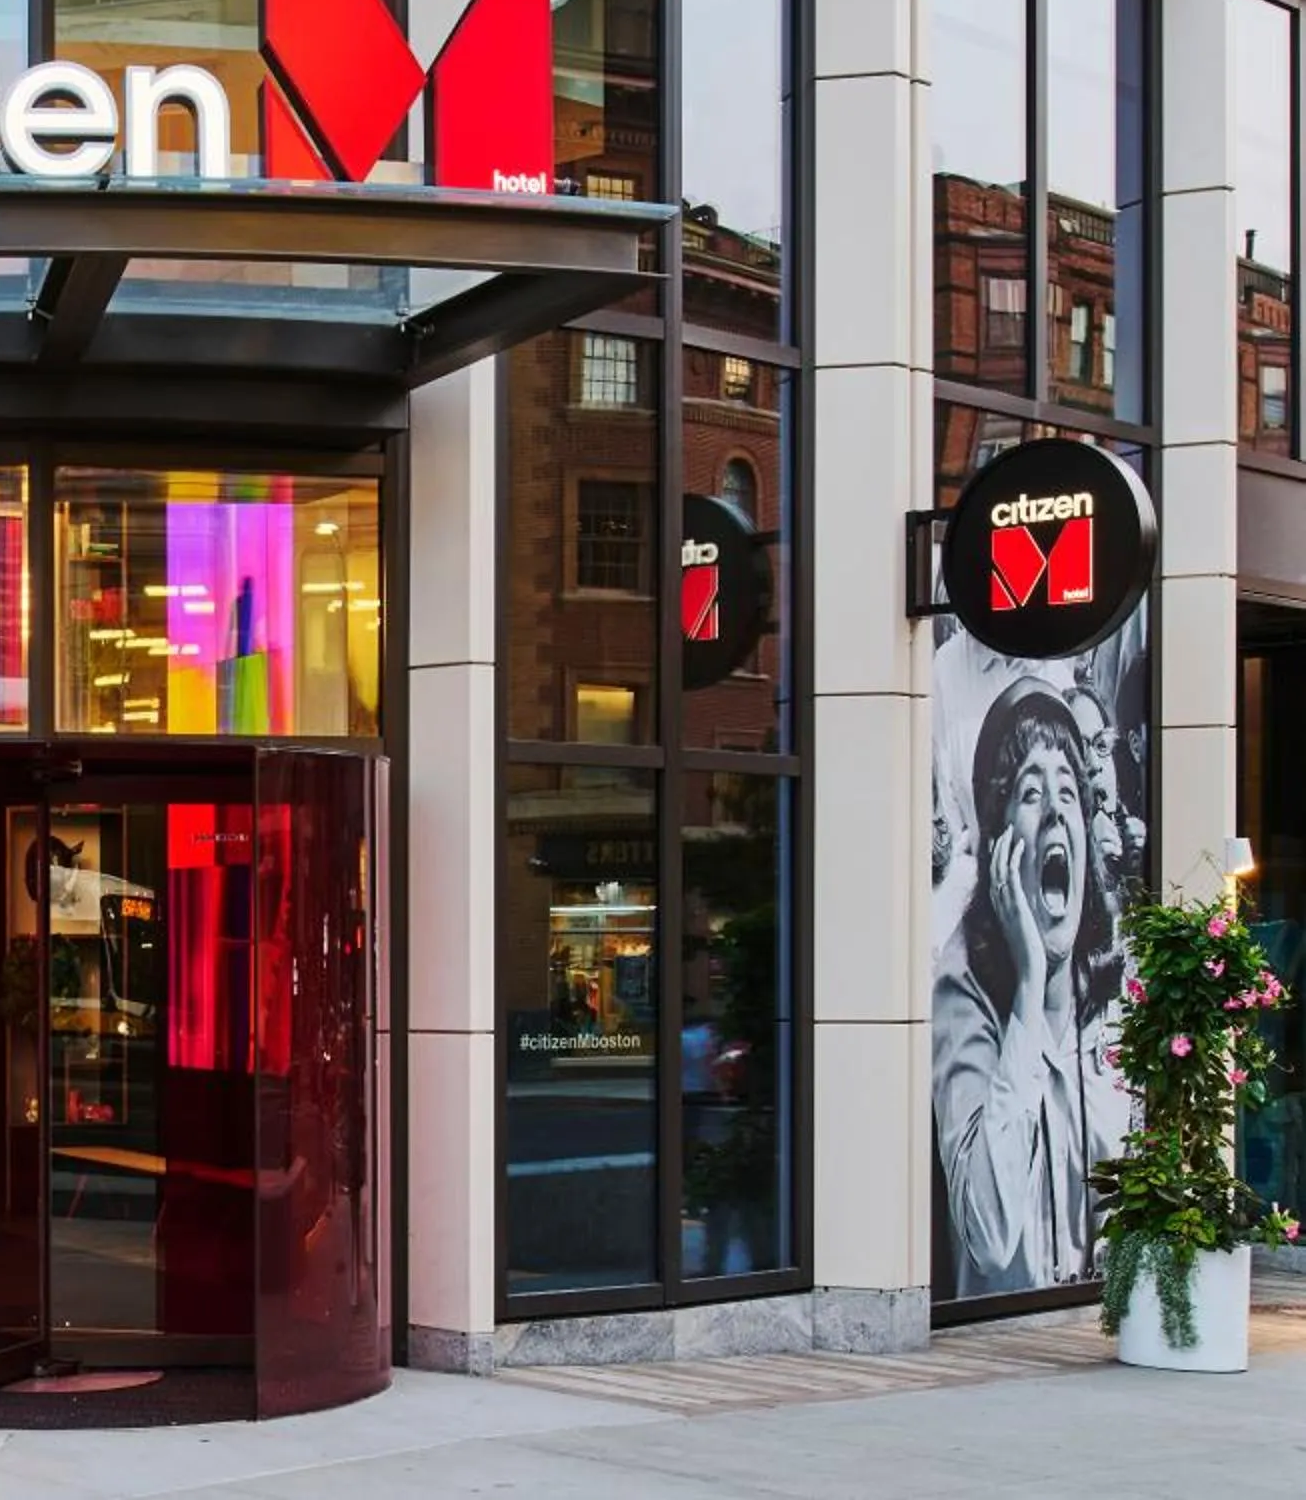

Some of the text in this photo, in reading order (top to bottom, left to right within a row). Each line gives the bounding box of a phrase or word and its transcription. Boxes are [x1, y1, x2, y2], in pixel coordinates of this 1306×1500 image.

[493, 168, 546, 194] hotel
[991, 492, 1093, 528] citizen
[520, 1033, 641, 1050] #citizenMboston
